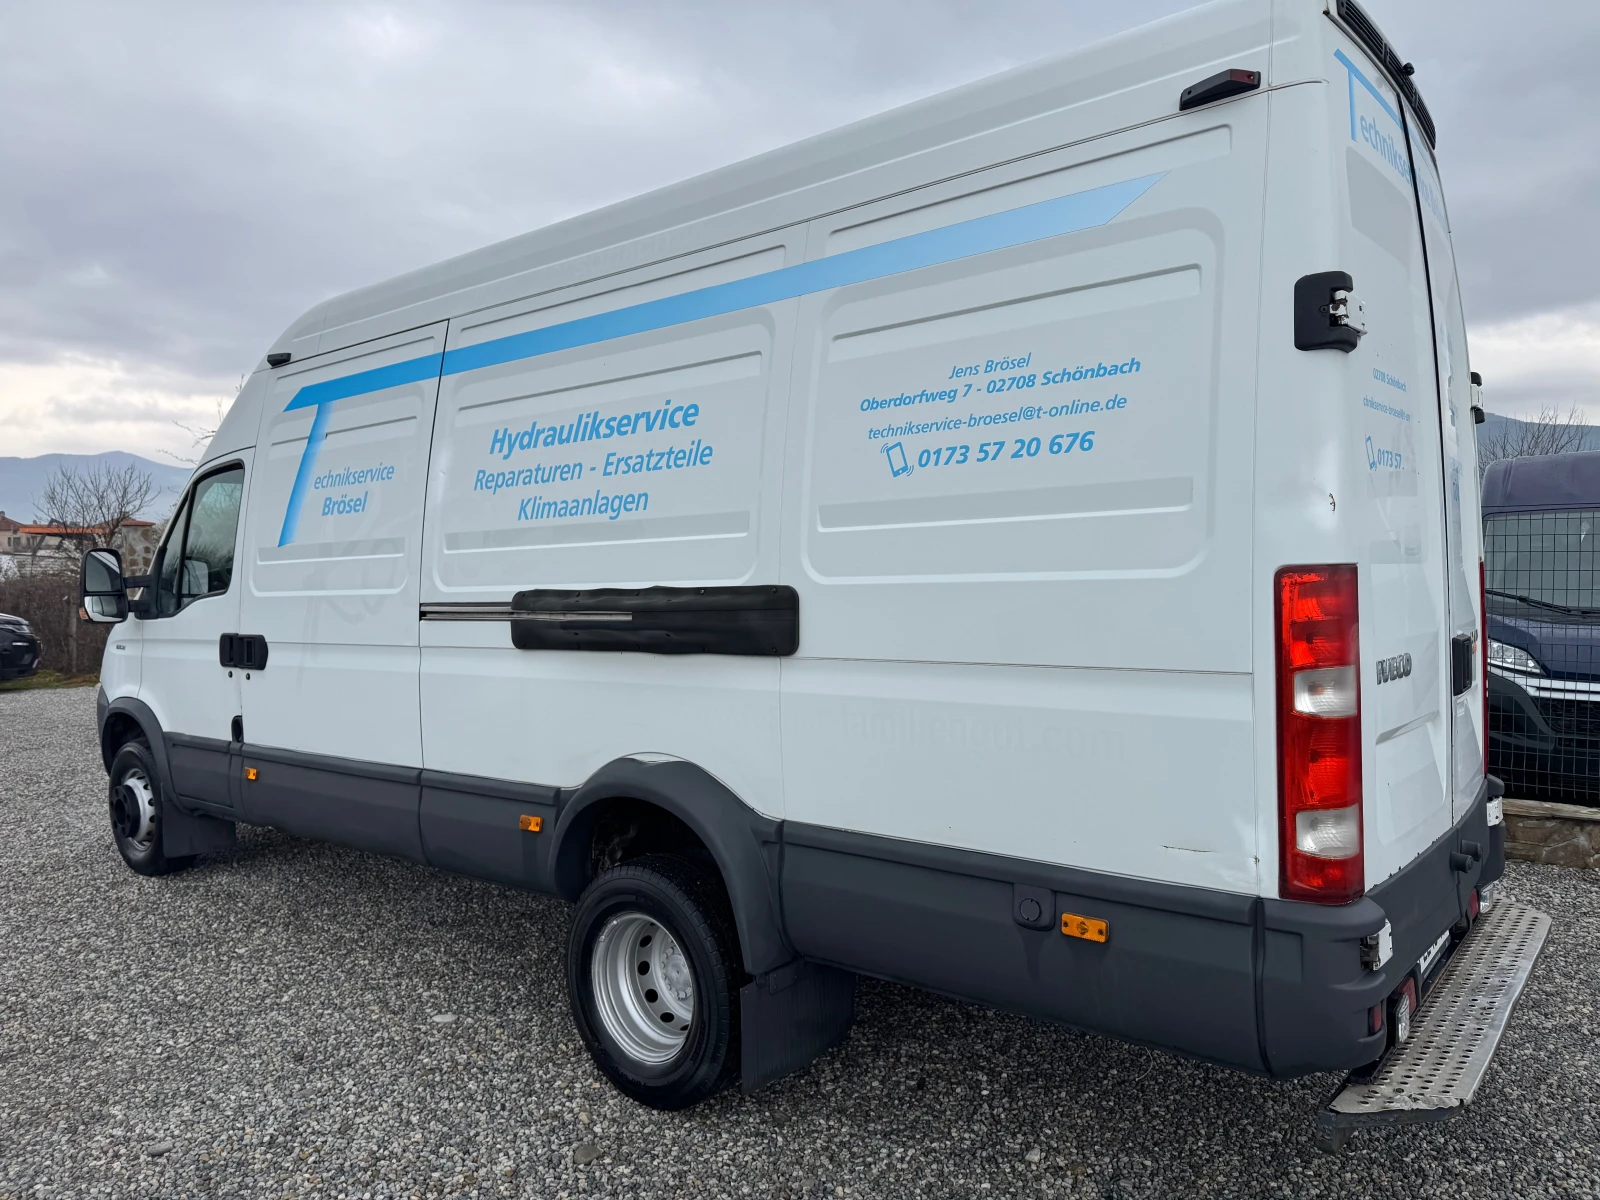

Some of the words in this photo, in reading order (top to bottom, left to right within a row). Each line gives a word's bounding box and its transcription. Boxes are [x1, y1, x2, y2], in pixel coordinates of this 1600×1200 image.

[948, 363, 980, 380] Jens
[983, 352, 1032, 375] Brösel
[859, 388, 958, 412] Oberdorfweg
[962, 383, 973, 398] 7
[986, 373, 1037, 394] 02708
[1040, 357, 1141, 387] Schönbach
[489, 399, 700, 460] Hydraulikservice
[867, 393, 1128, 440] technikservice-broesel@t-online.de
[474, 461, 583, 495] Reparaturen
[602, 439, 714, 477] Ersatzteile
[917, 445, 970, 468] 0173
[975, 441, 1006, 463] 57
[1010, 436, 1042, 459] 20
[1048, 430, 1096, 455] 676
[1377, 448, 1393, 467] 0173
[321, 491, 369, 517] Brösel
[517, 489, 649, 521] Klimaanlagen
[1375, 652, 1412, 686] IVECO
